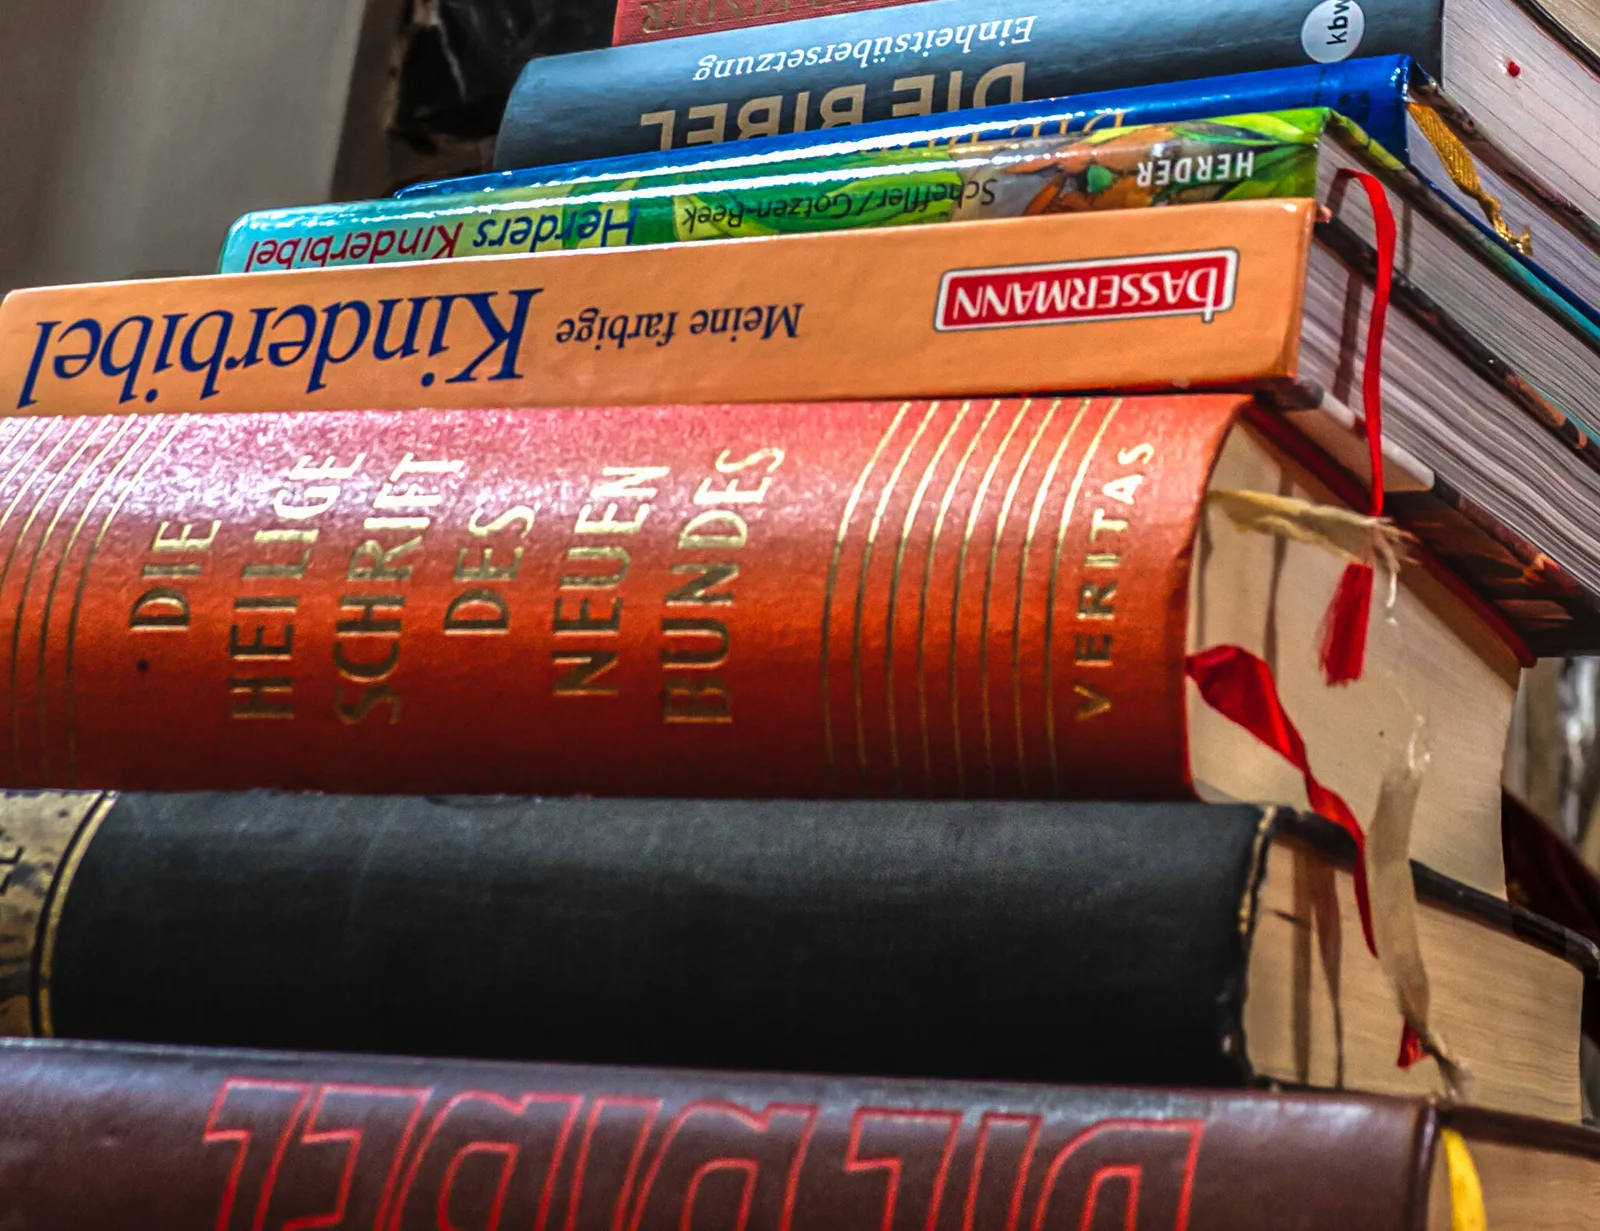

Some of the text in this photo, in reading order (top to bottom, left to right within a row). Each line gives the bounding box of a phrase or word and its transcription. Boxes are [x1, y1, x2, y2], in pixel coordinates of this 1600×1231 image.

[692, 15, 1038, 81] Einheitsübersetzung
[1137, 150, 1255, 187] HERDER
[245, 203, 640, 273] Herders Kinderbibel
[16, 287, 804, 410] Meine farbige Kinderbibel
[129, 519, 222, 634] DIE
[228, 452, 367, 721] HEILIGE
[332, 451, 469, 727] SCHRIFT
[442, 502, 539, 637] DES
[551, 464, 670, 697] NEUEN
[659, 446, 786, 725] BUNDES
[1074, 441, 1156, 723] VERITAS
